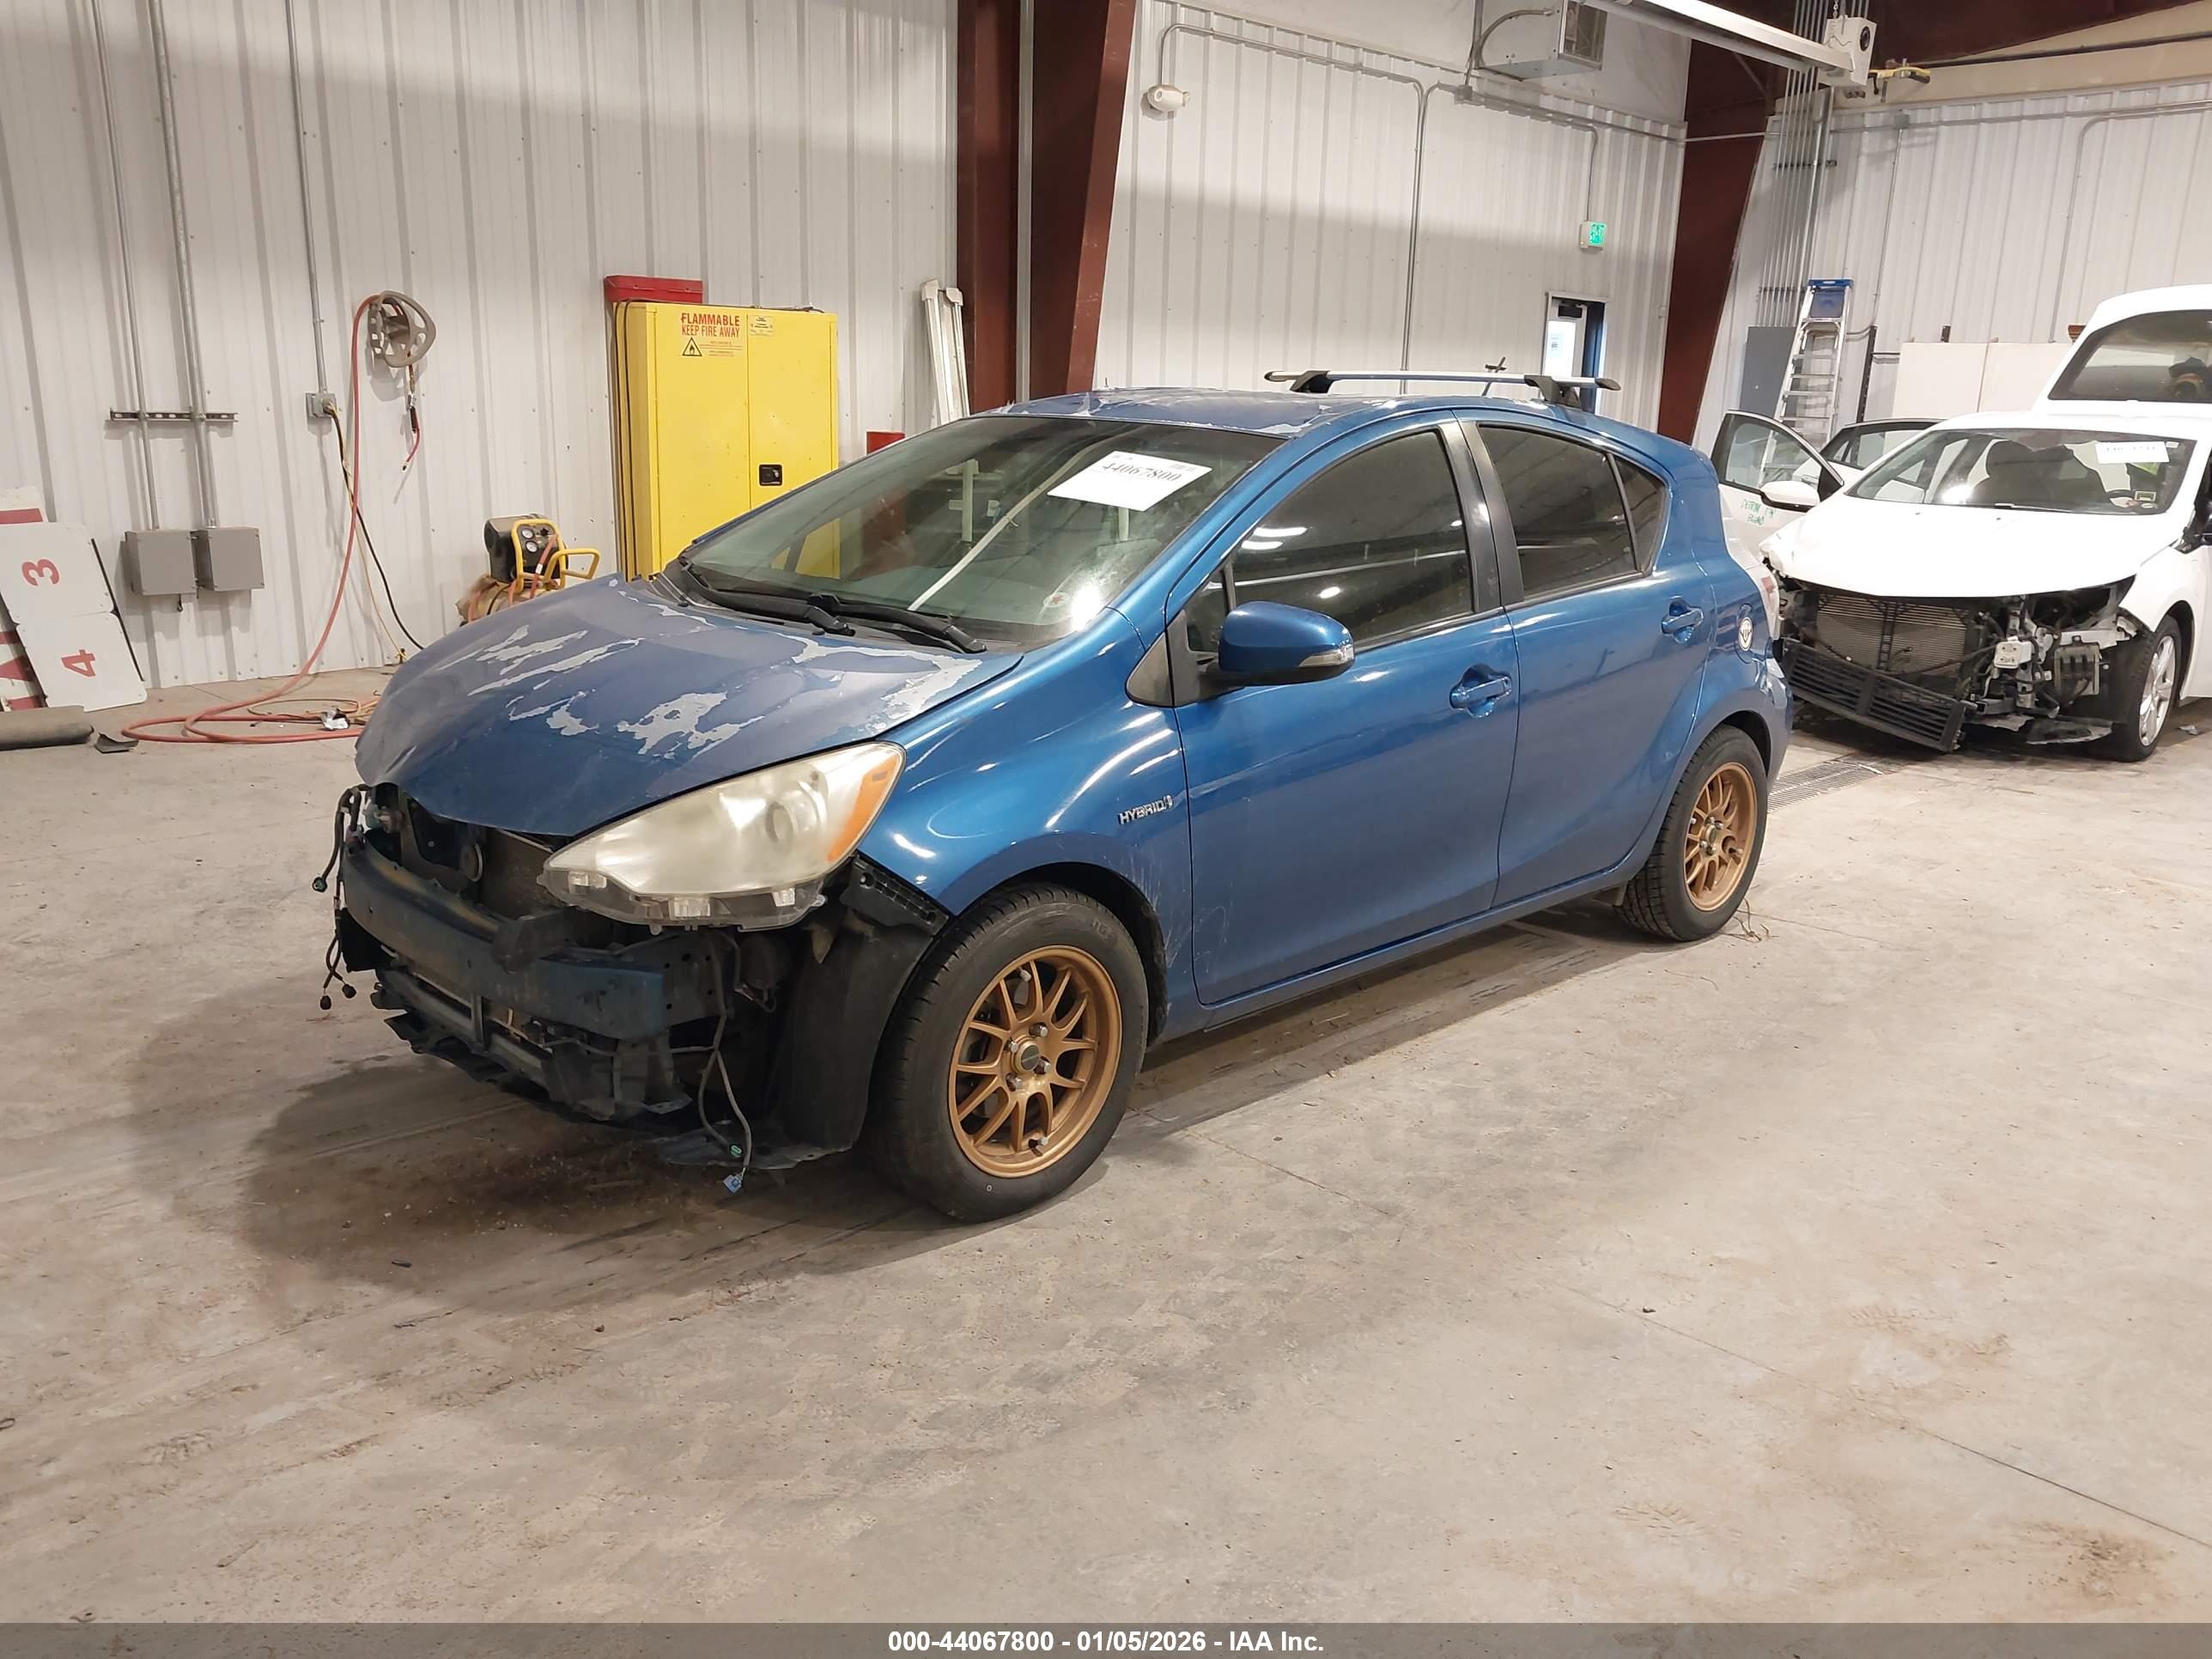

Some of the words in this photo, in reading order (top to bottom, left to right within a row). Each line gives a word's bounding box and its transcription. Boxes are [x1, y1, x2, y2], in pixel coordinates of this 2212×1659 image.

[681, 313, 740, 326] FLAMMABLE
[682, 325, 700, 337] KEEP
[702, 326, 718, 337] FIRE
[720, 327, 740, 338] AWAY
[21, 558, 60, 586] 3
[61, 649, 96, 678] 4
[1119, 799, 1167, 825] HYBRID
